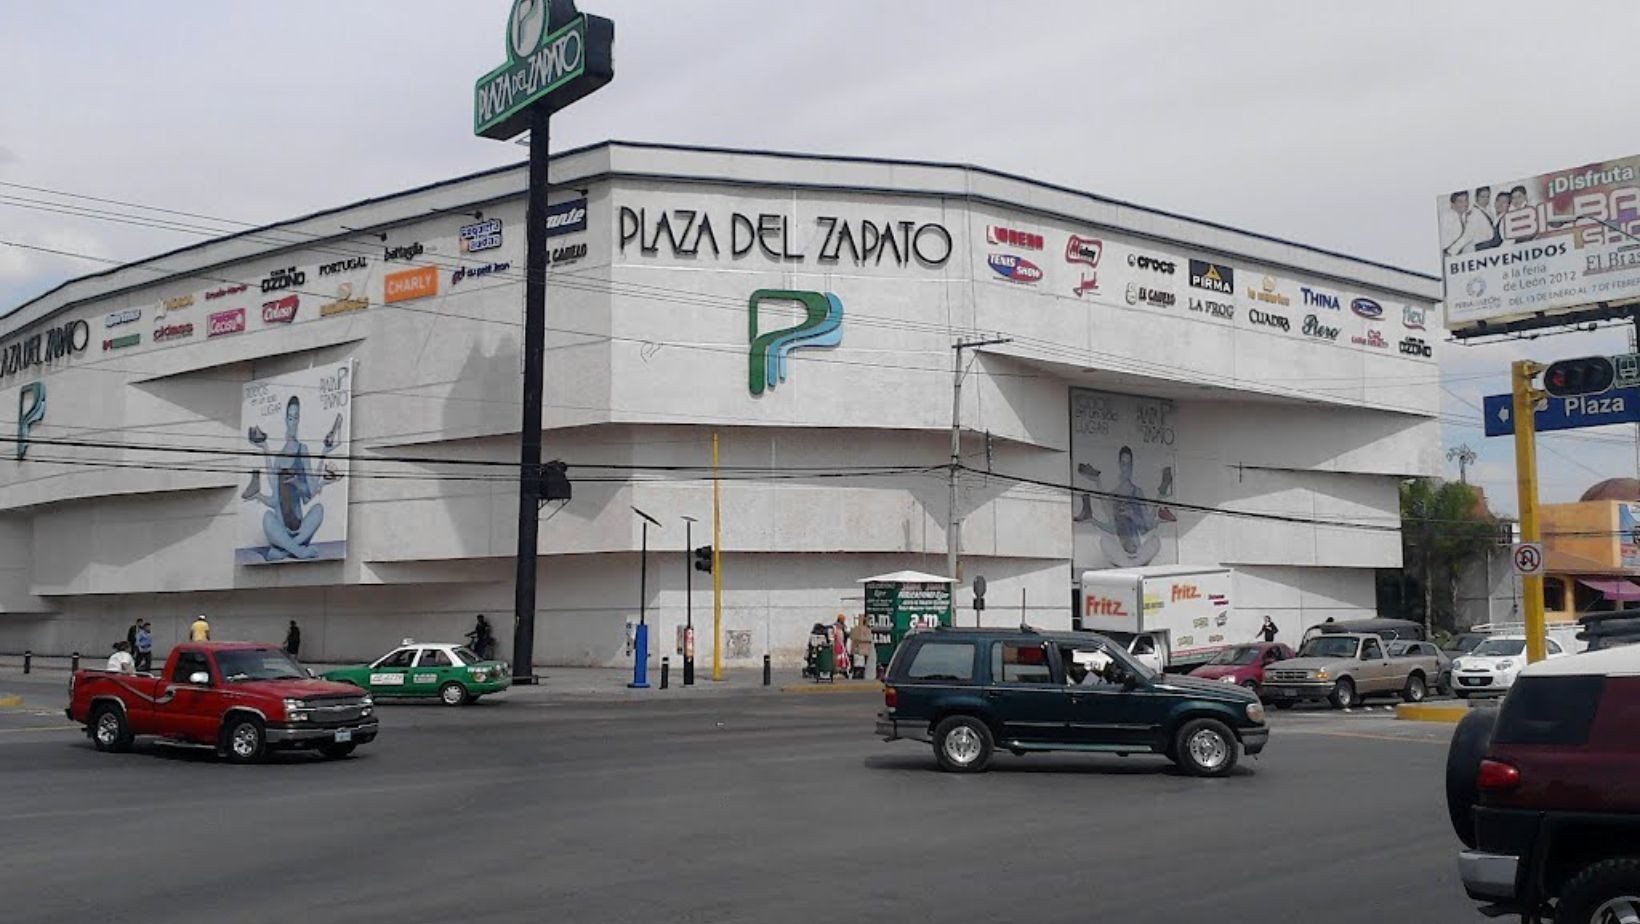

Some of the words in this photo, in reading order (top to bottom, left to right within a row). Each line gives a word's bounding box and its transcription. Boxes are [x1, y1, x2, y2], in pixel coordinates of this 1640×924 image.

[479, 72, 513, 124] PLAZA
[512, 69, 527, 95] DEL
[526, 29, 581, 95] ZAPATO
[620, 206, 720, 256] PLAZA
[732, 213, 804, 260] DEL
[817, 216, 952, 266] ZAPATO
[320, 257, 368, 276] PORTUGAL
[989, 253, 1016, 268] TENIS
[1137, 255, 1176, 274] crocs
[1450, 242, 1567, 274] BIENVENIDOS
[261, 271, 305, 292] OZONO
[1016, 265, 1040, 279] SHOW
[1503, 281, 1517, 292] de
[1519, 276, 1546, 290] León
[1549, 271, 1576, 285] 2012
[1511, 268, 1520, 278] la
[1523, 264, 1546, 276] feria
[388, 274, 432, 295] CHARLY
[1192, 274, 1231, 293] PIRMA
[1189, 297, 1203, 312] LA
[1206, 301, 1234, 318] FROG
[1300, 287, 1340, 311] THINA
[1565, 397, 1625, 417] Plaza
[1171, 583, 1201, 603] Fritz
[1085, 595, 1128, 617] Fritz
